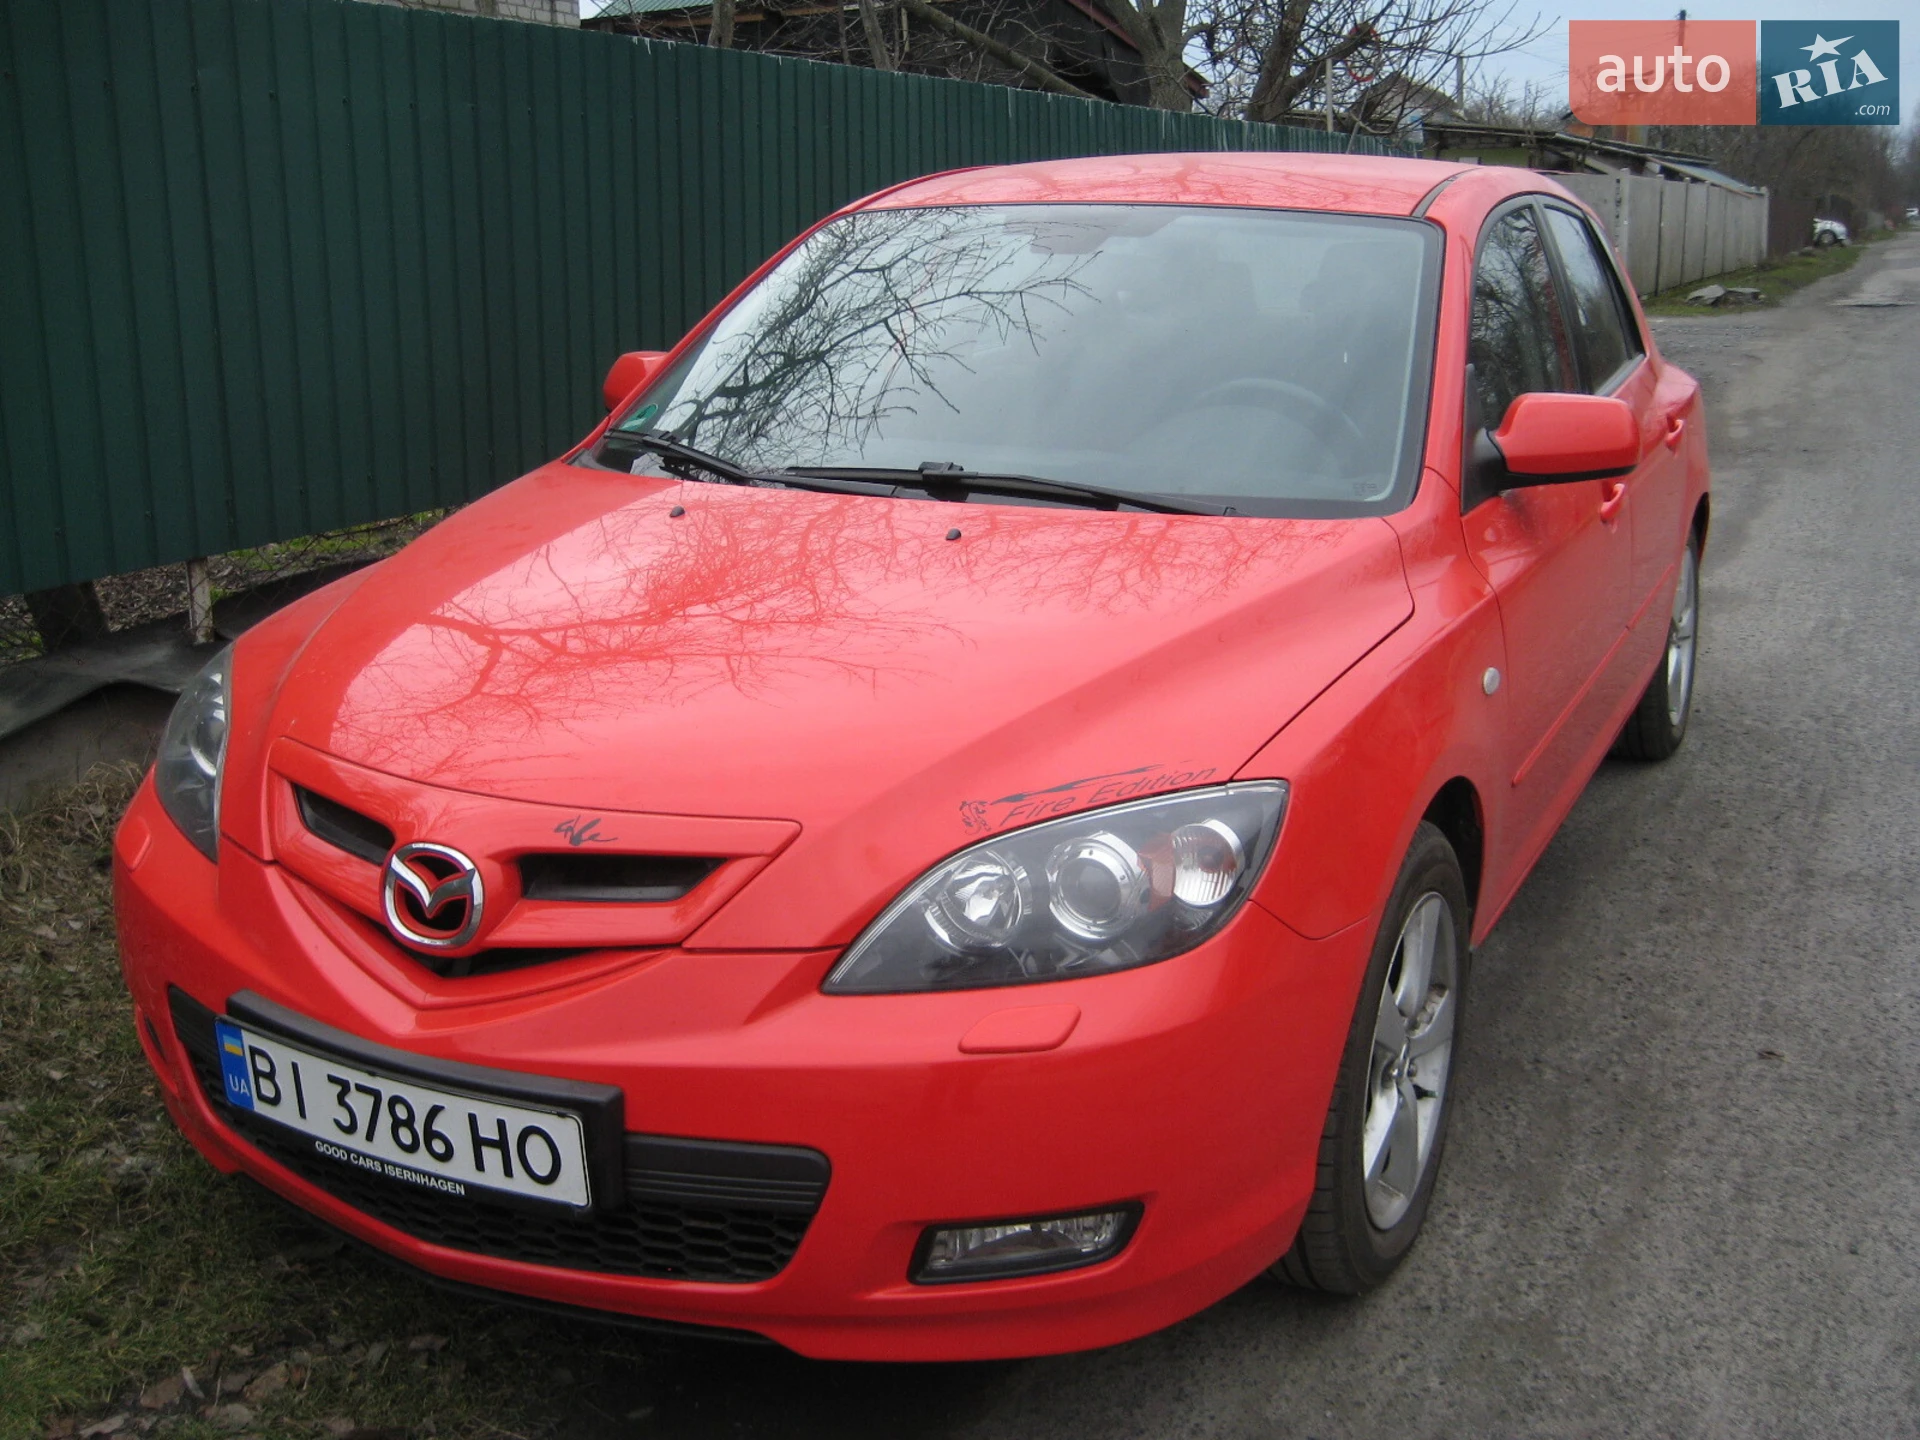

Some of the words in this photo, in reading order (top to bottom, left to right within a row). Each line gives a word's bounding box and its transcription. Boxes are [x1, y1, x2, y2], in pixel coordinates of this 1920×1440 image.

[1000, 793, 1077, 827] Fire
[1089, 767, 1217, 805] Edition
[229, 1075, 251, 1097] UA
[249, 1045, 307, 1120] BI
[327, 1073, 455, 1162] 3786
[467, 1112, 562, 1186] HO
[315, 1140, 348, 1161] GOOD
[350, 1153, 382, 1173] CARS
[384, 1163, 465, 1196] ISERNHAGEN
